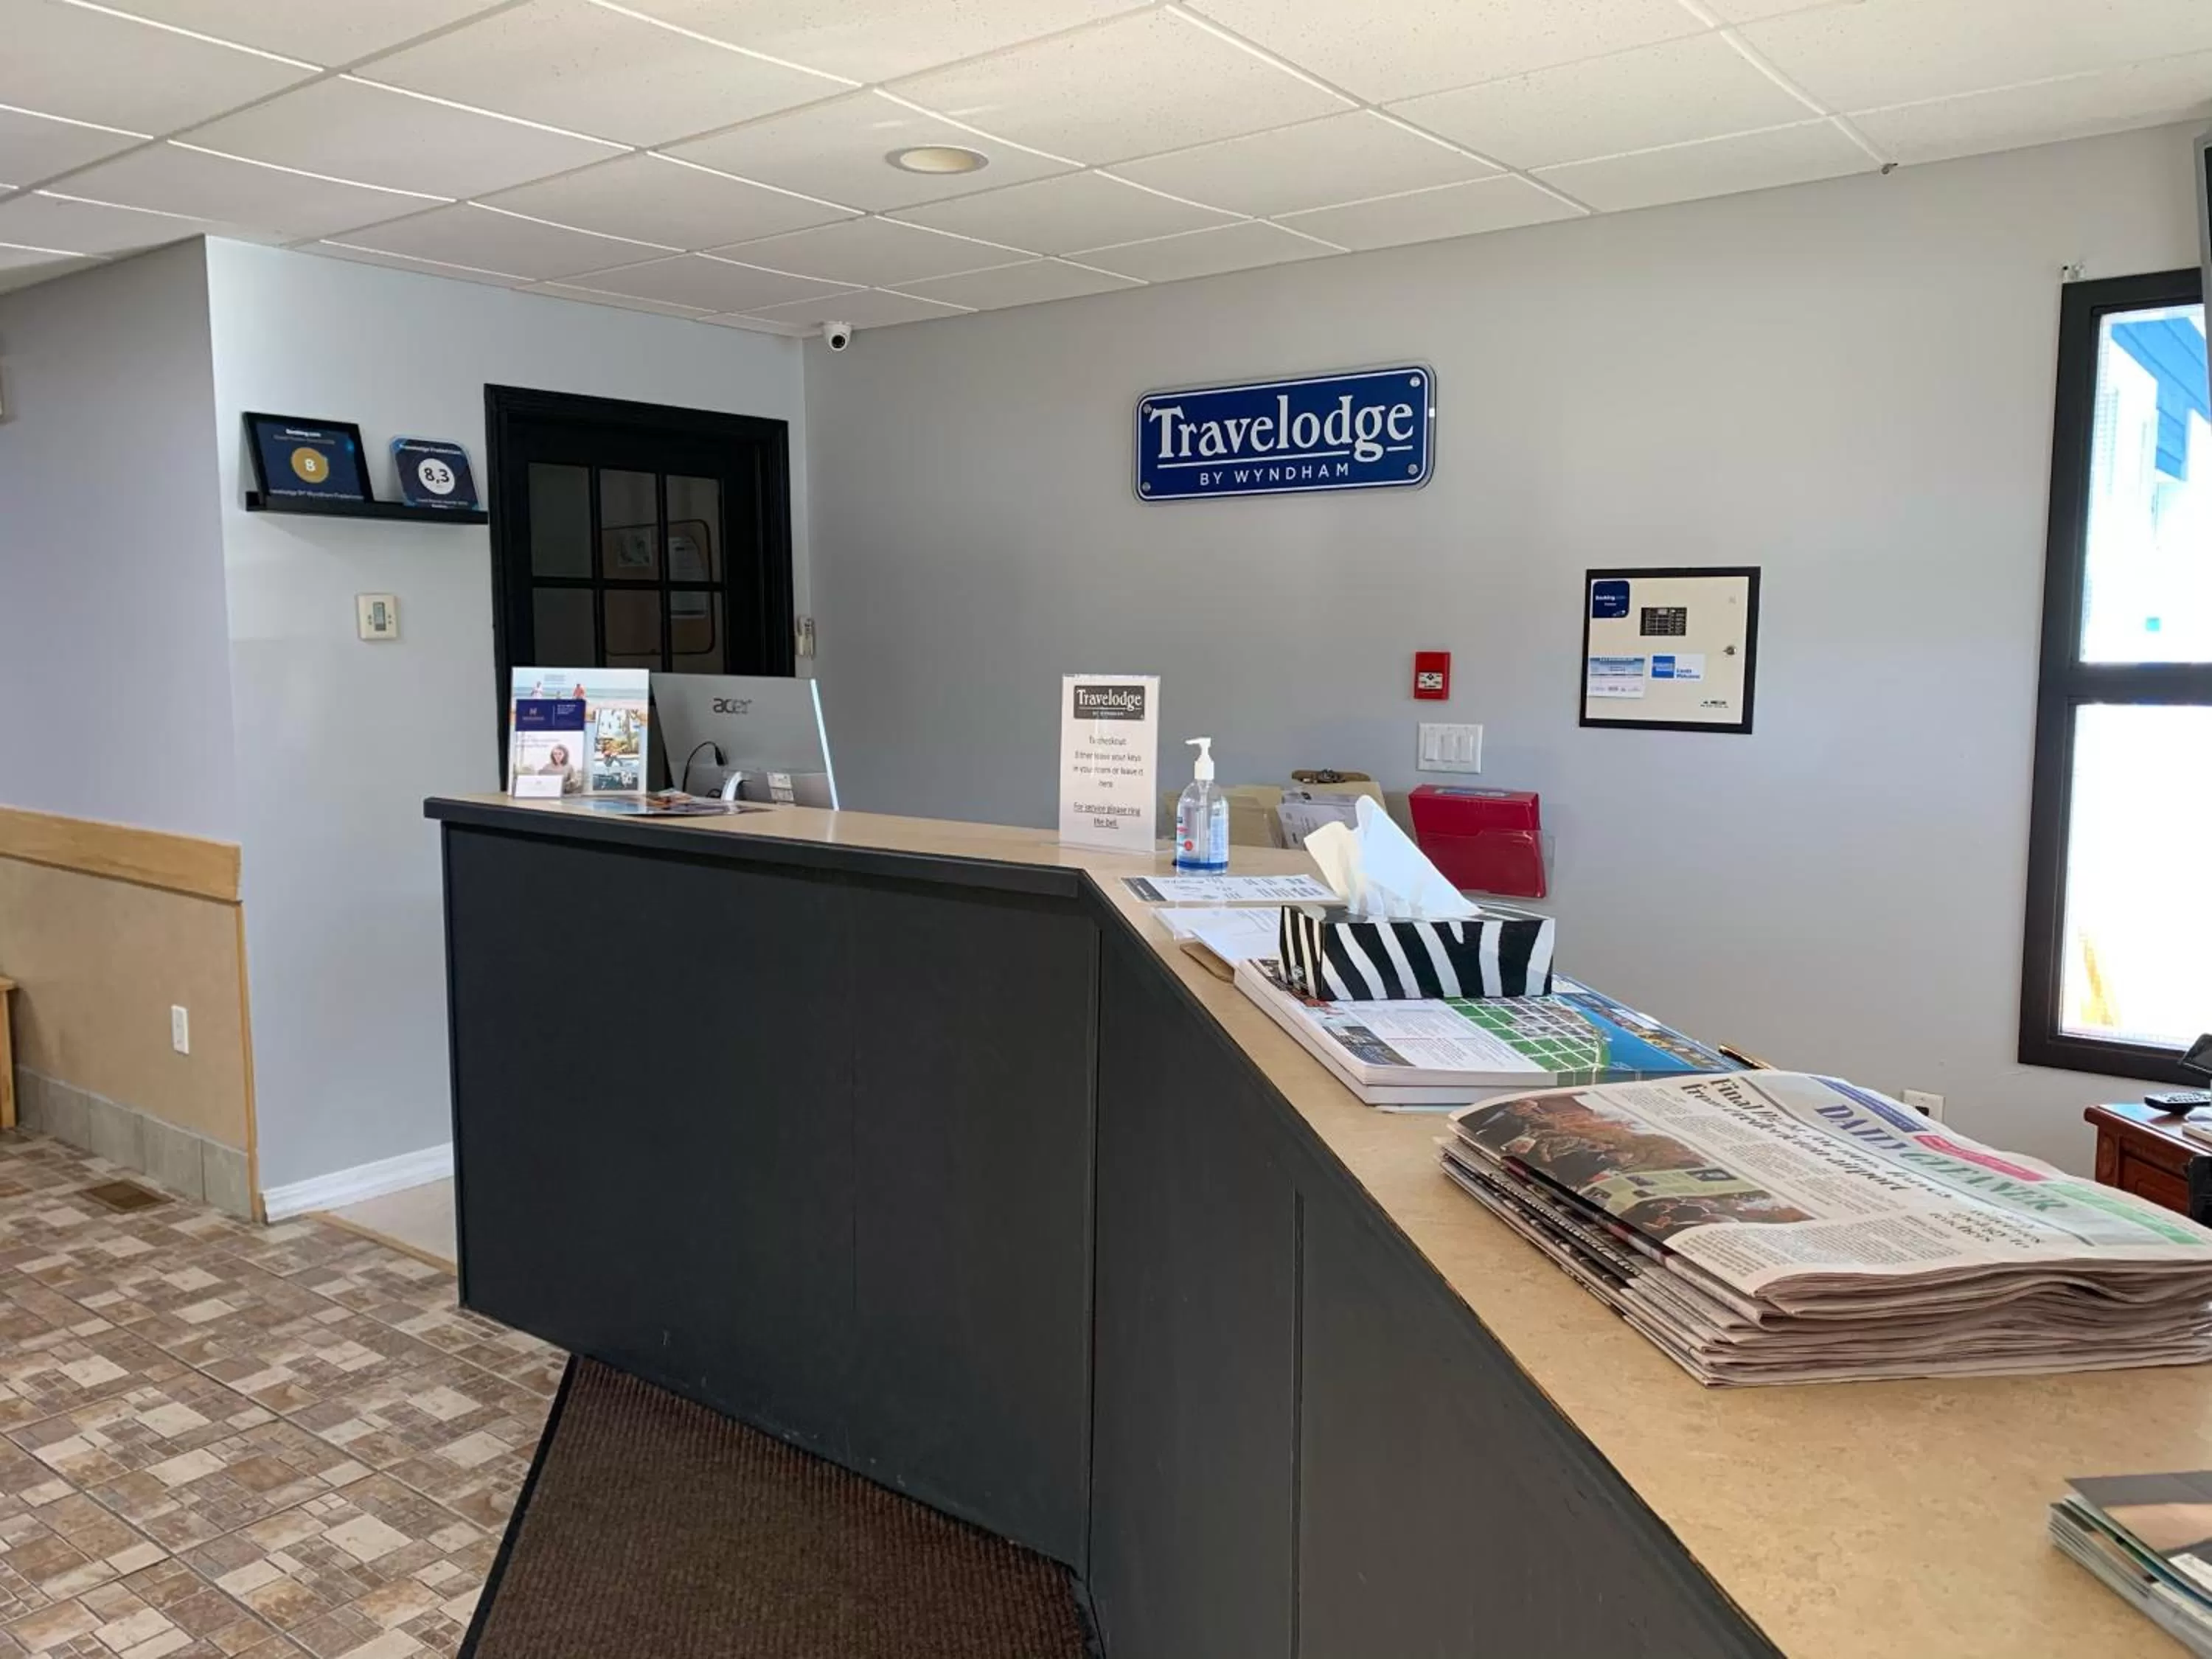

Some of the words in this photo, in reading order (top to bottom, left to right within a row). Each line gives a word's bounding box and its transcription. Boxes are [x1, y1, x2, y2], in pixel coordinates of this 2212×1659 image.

[1149, 394, 1413, 462] Travelodge
[305, 458, 316, 472] 8
[424, 467, 450, 484] 8.3
[1200, 472, 1223, 486] BY
[1234, 462, 1349, 484] WYNDHAM
[713, 698, 753, 714] acer
[1077, 689, 1141, 712] Travelodge
[1709, 1078, 1764, 1110] Final
[1815, 1105, 1910, 1150] DAILY
[1899, 1152, 2069, 1212] GLEANER
